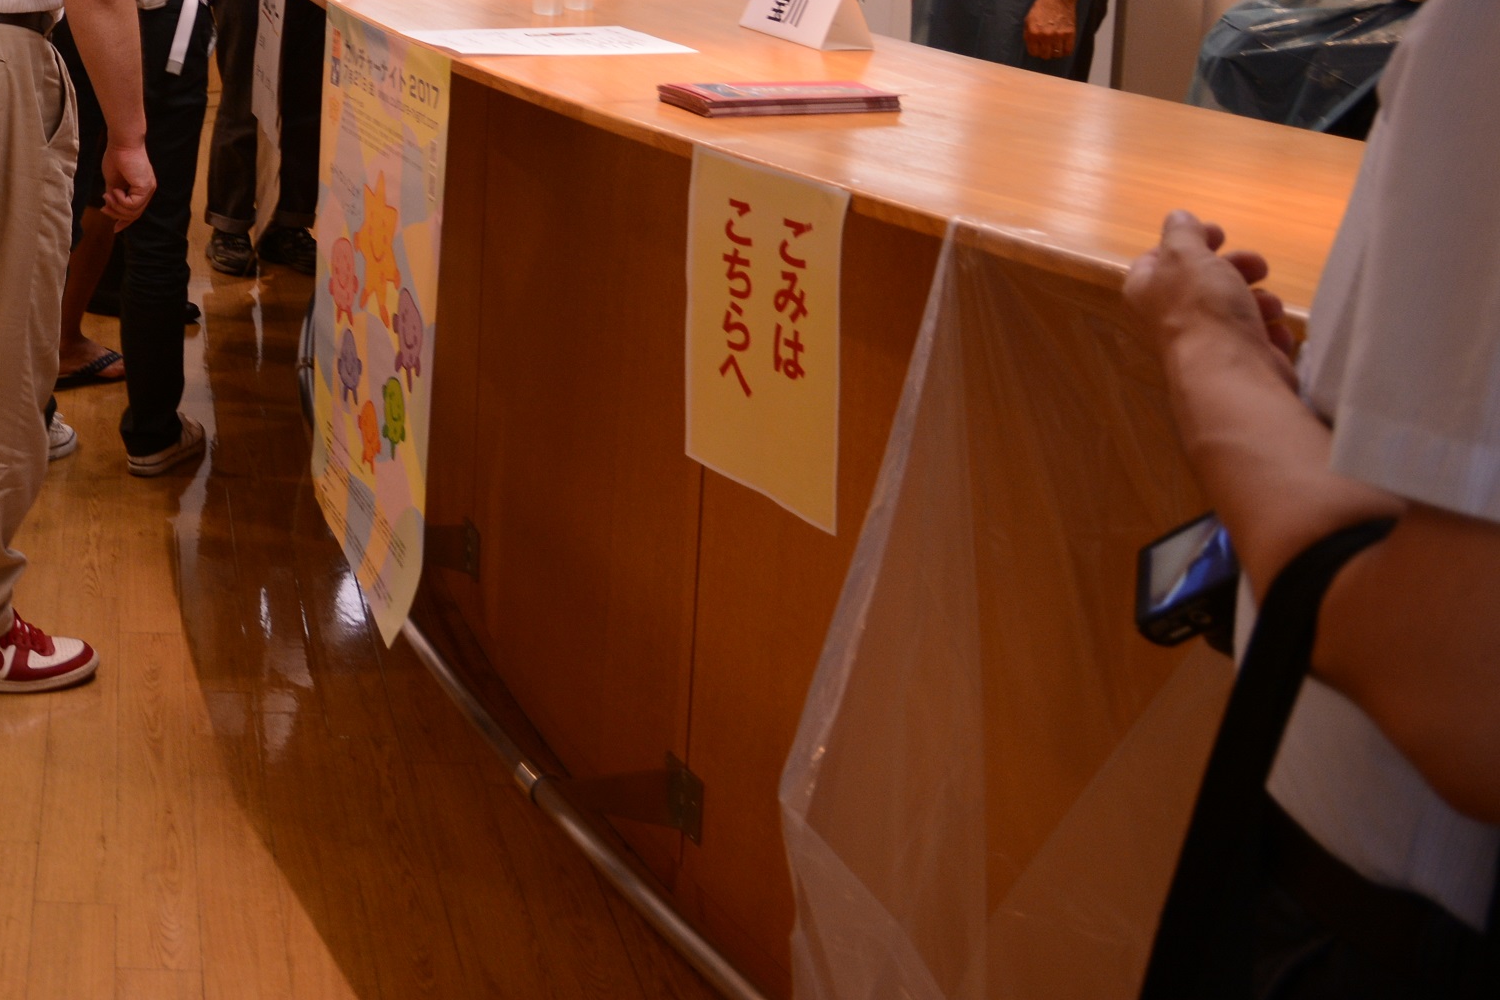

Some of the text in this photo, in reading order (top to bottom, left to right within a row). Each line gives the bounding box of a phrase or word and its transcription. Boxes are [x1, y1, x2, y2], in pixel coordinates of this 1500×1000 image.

[408, 74, 441, 110] 2017
[719, 197, 753, 398] こちらへ
[773, 217, 813, 381] ごみは
